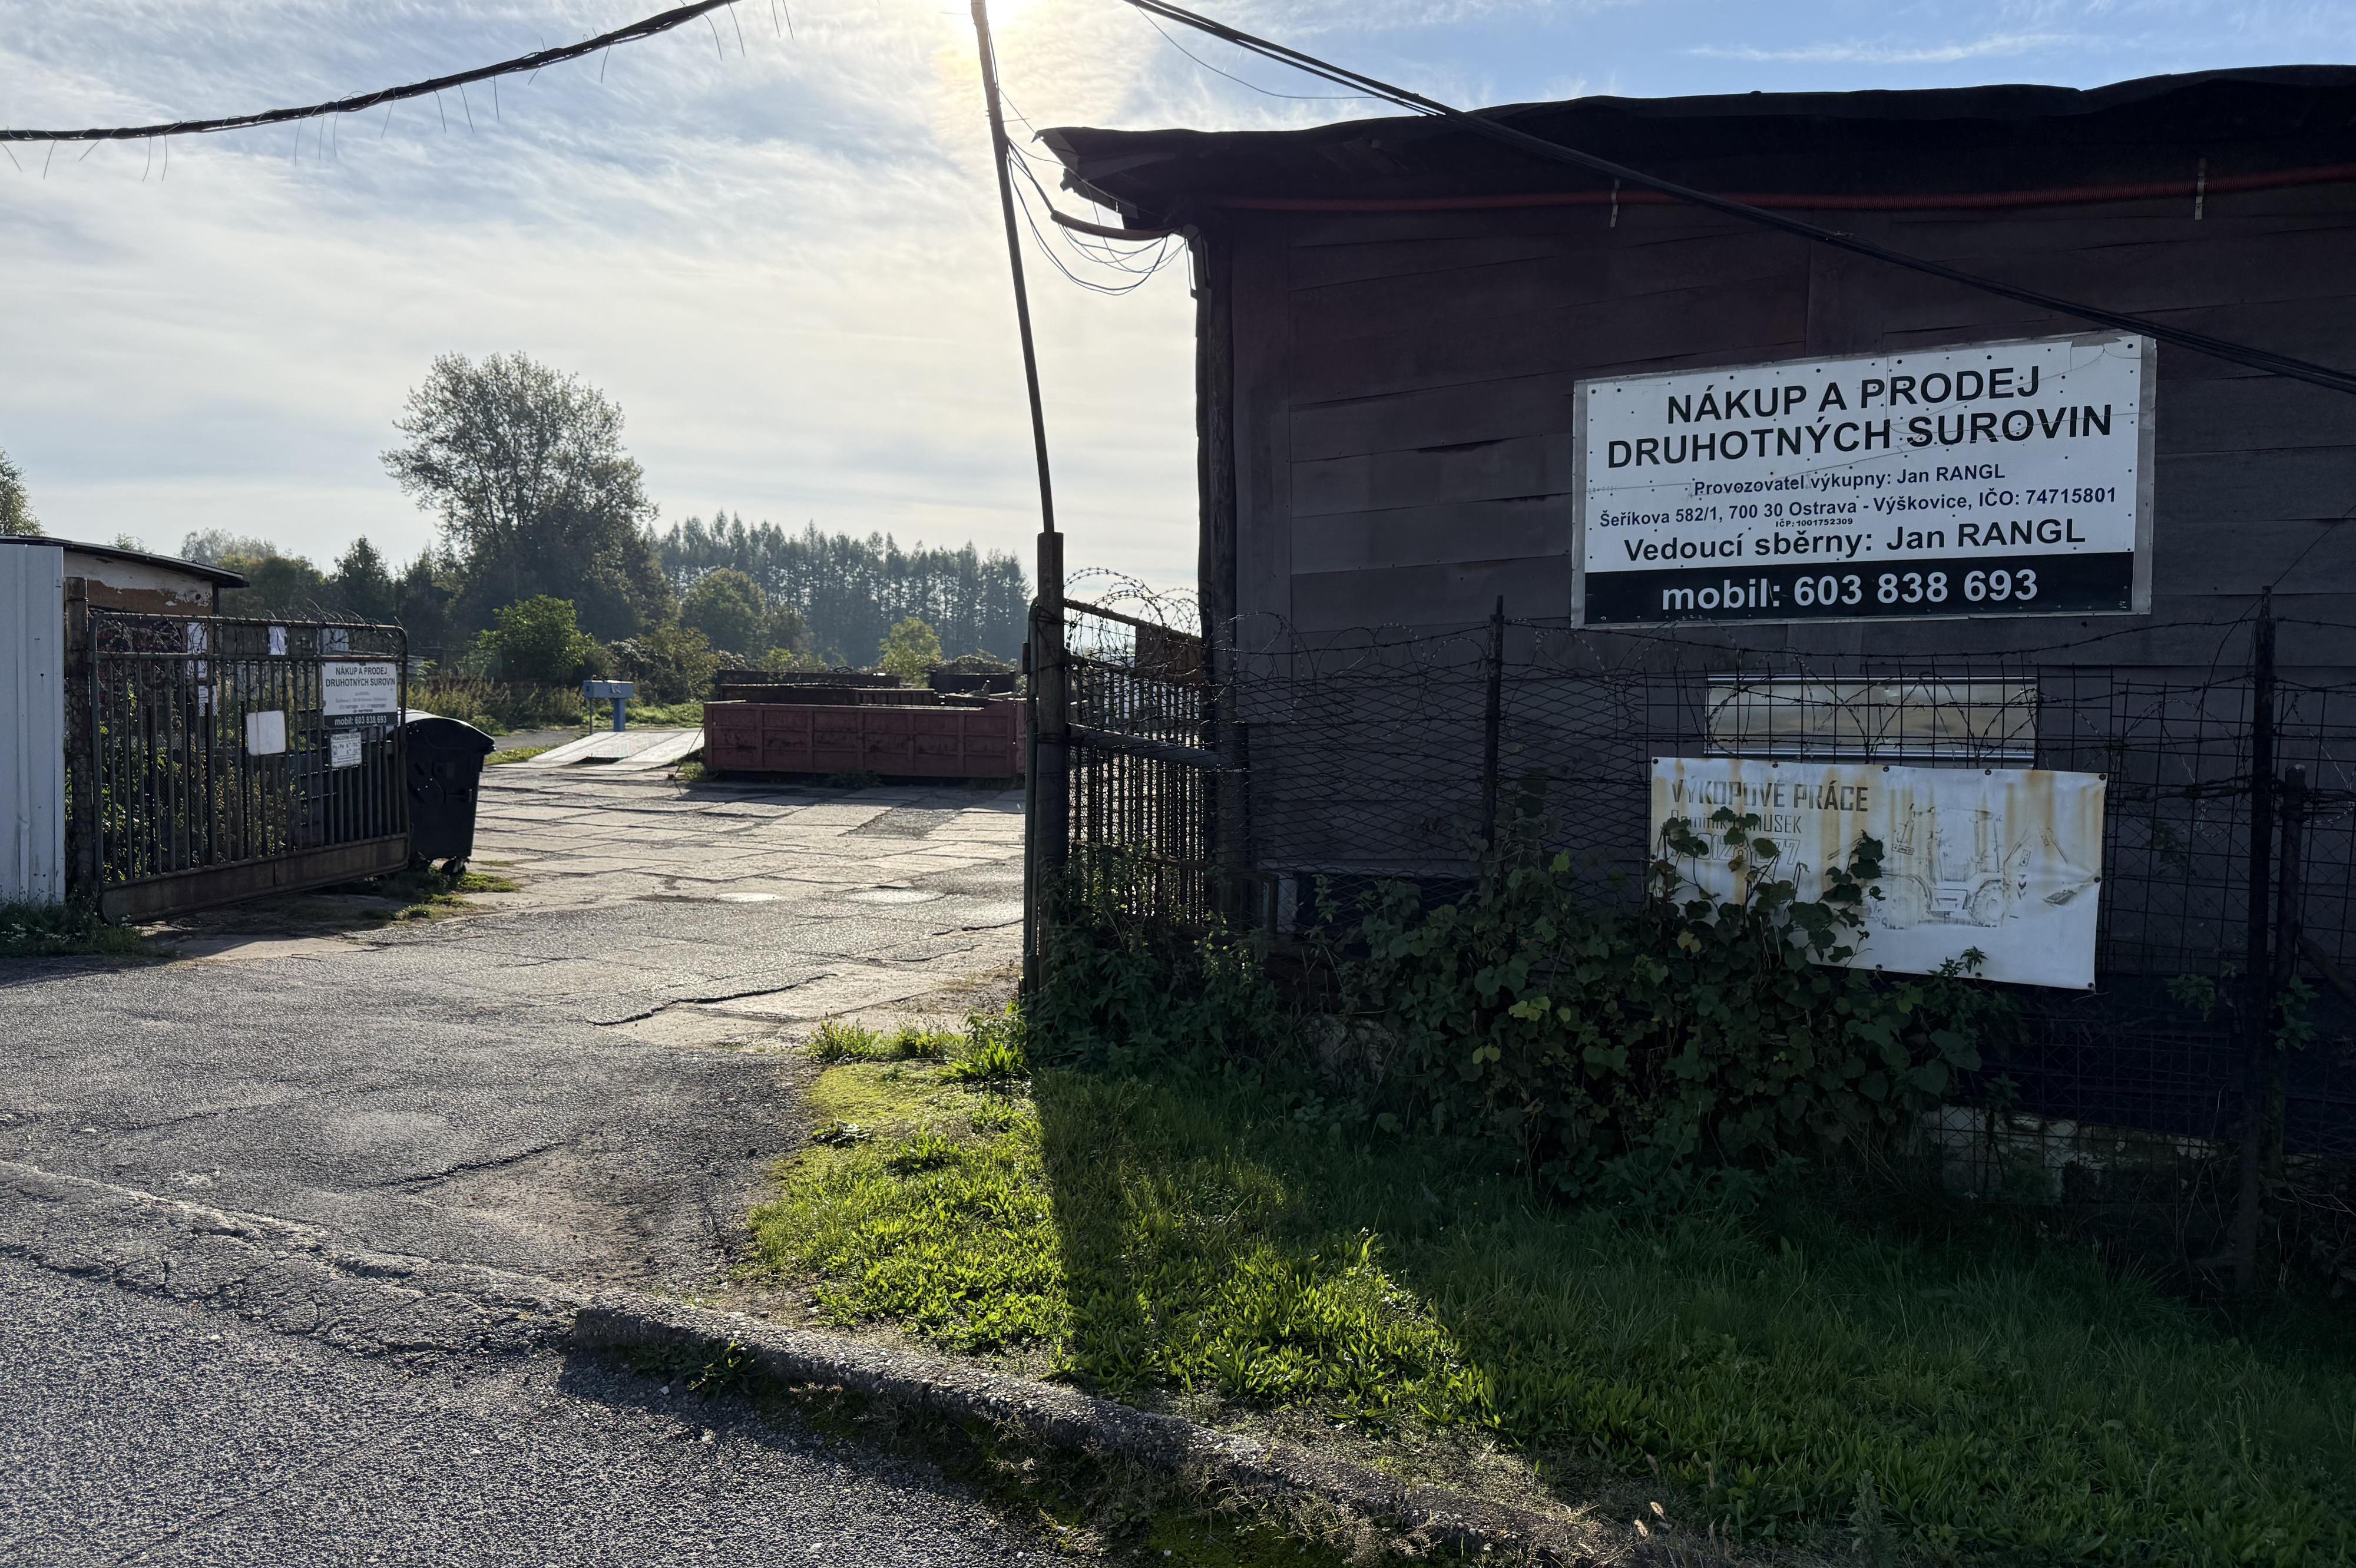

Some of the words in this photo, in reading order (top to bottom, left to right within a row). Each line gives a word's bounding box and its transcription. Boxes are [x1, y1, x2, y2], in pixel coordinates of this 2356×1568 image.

[1667, 384, 1806, 424] NÁKUP
[1818, 382, 1848, 412] A
[1861, 365, 2039, 409] PRODEJ
[1608, 416, 1891, 468] DRUHOTNÝCH
[1907, 403, 2112, 448] SUROVIN
[1694, 474, 1804, 496] Provozovatel
[1810, 473, 1890, 491] výkupny:
[1897, 469, 1929, 484] Jan
[1936, 464, 2005, 482] RANGL
[1600, 510, 1669, 527] Šeříkova
[1675, 506, 1723, 524] 582/1,
[1729, 504, 1758, 520] 700
[1763, 502, 1783, 518] 30
[1789, 500, 1857, 516] Ostrava
[1873, 494, 1972, 515] Výškovice,
[1979, 487, 2019, 507] IČO:
[2026, 487, 2115, 505] 74715801
[1624, 532, 1743, 561] Vedoucí
[1755, 530, 1872, 558] sběrny:
[1886, 526, 1944, 550] Jan
[1958, 518, 2086, 547] RANGL
[1662, 578, 1780, 610] mobil:
[1794, 574, 1862, 606] 603
[1877, 571, 1948, 604] 838
[1964, 568, 2038, 601] 693
[326, 677, 369, 687] DRUHOTNÝCH
[335, 666, 358, 676] NÁKUP
[364, 667, 388, 675] PRODEJ
[335, 716, 354, 726] mobil:
[355, 716, 365, 725] 603
[377, 714, 387, 723] 693
[1671, 776, 1785, 808] VÝKOPOVÉ
[1794, 780, 1868, 812] PRÁCE
